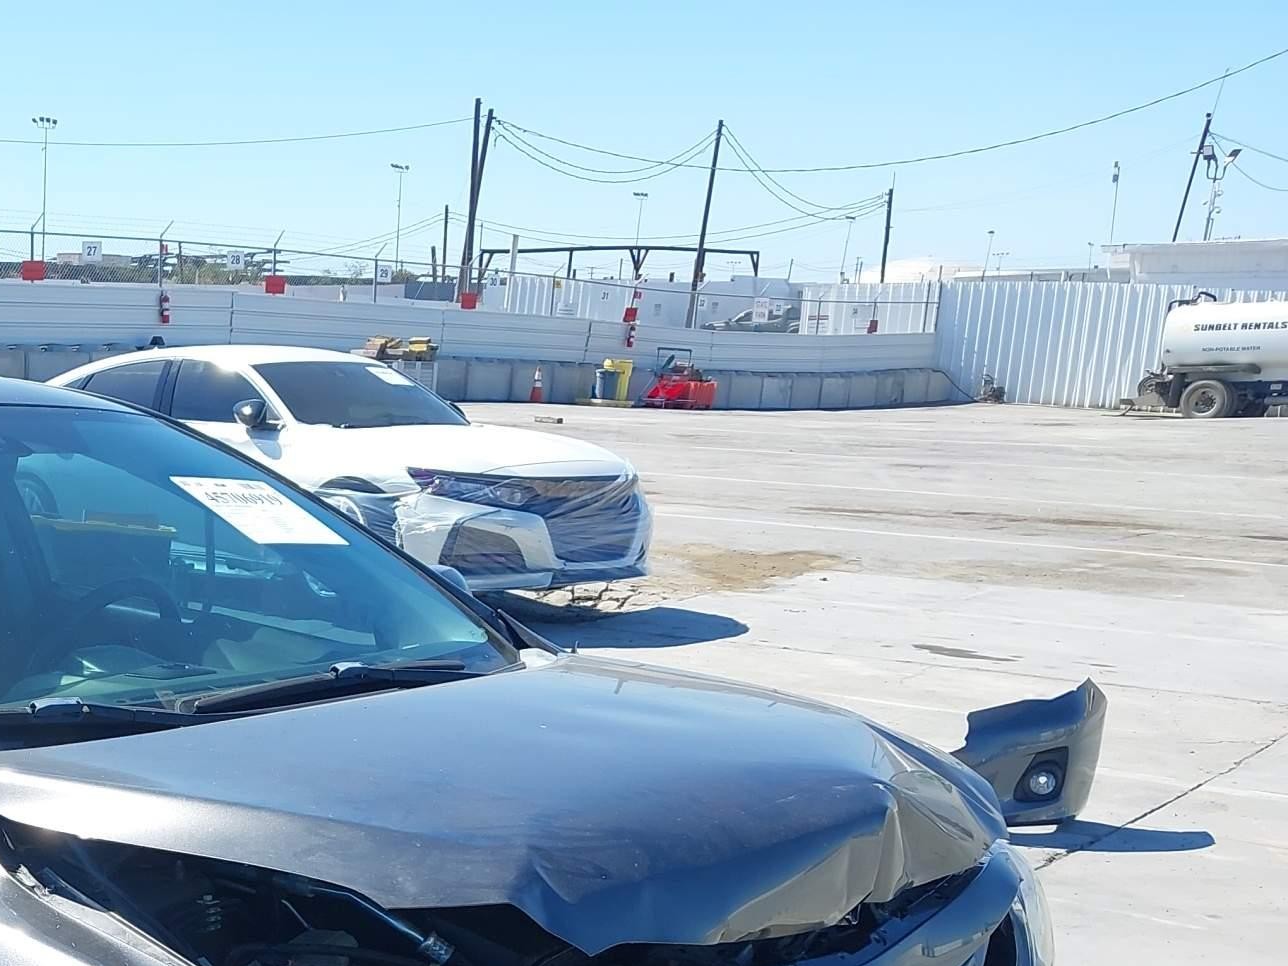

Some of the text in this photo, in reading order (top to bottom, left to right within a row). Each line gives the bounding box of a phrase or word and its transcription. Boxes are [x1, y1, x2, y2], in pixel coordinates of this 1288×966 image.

[86, 245, 98, 256] 27
[230, 254, 241, 265] 28
[601, 291, 609, 300] 31
[1194, 321, 1288, 331] SUNBELT RENTALS
